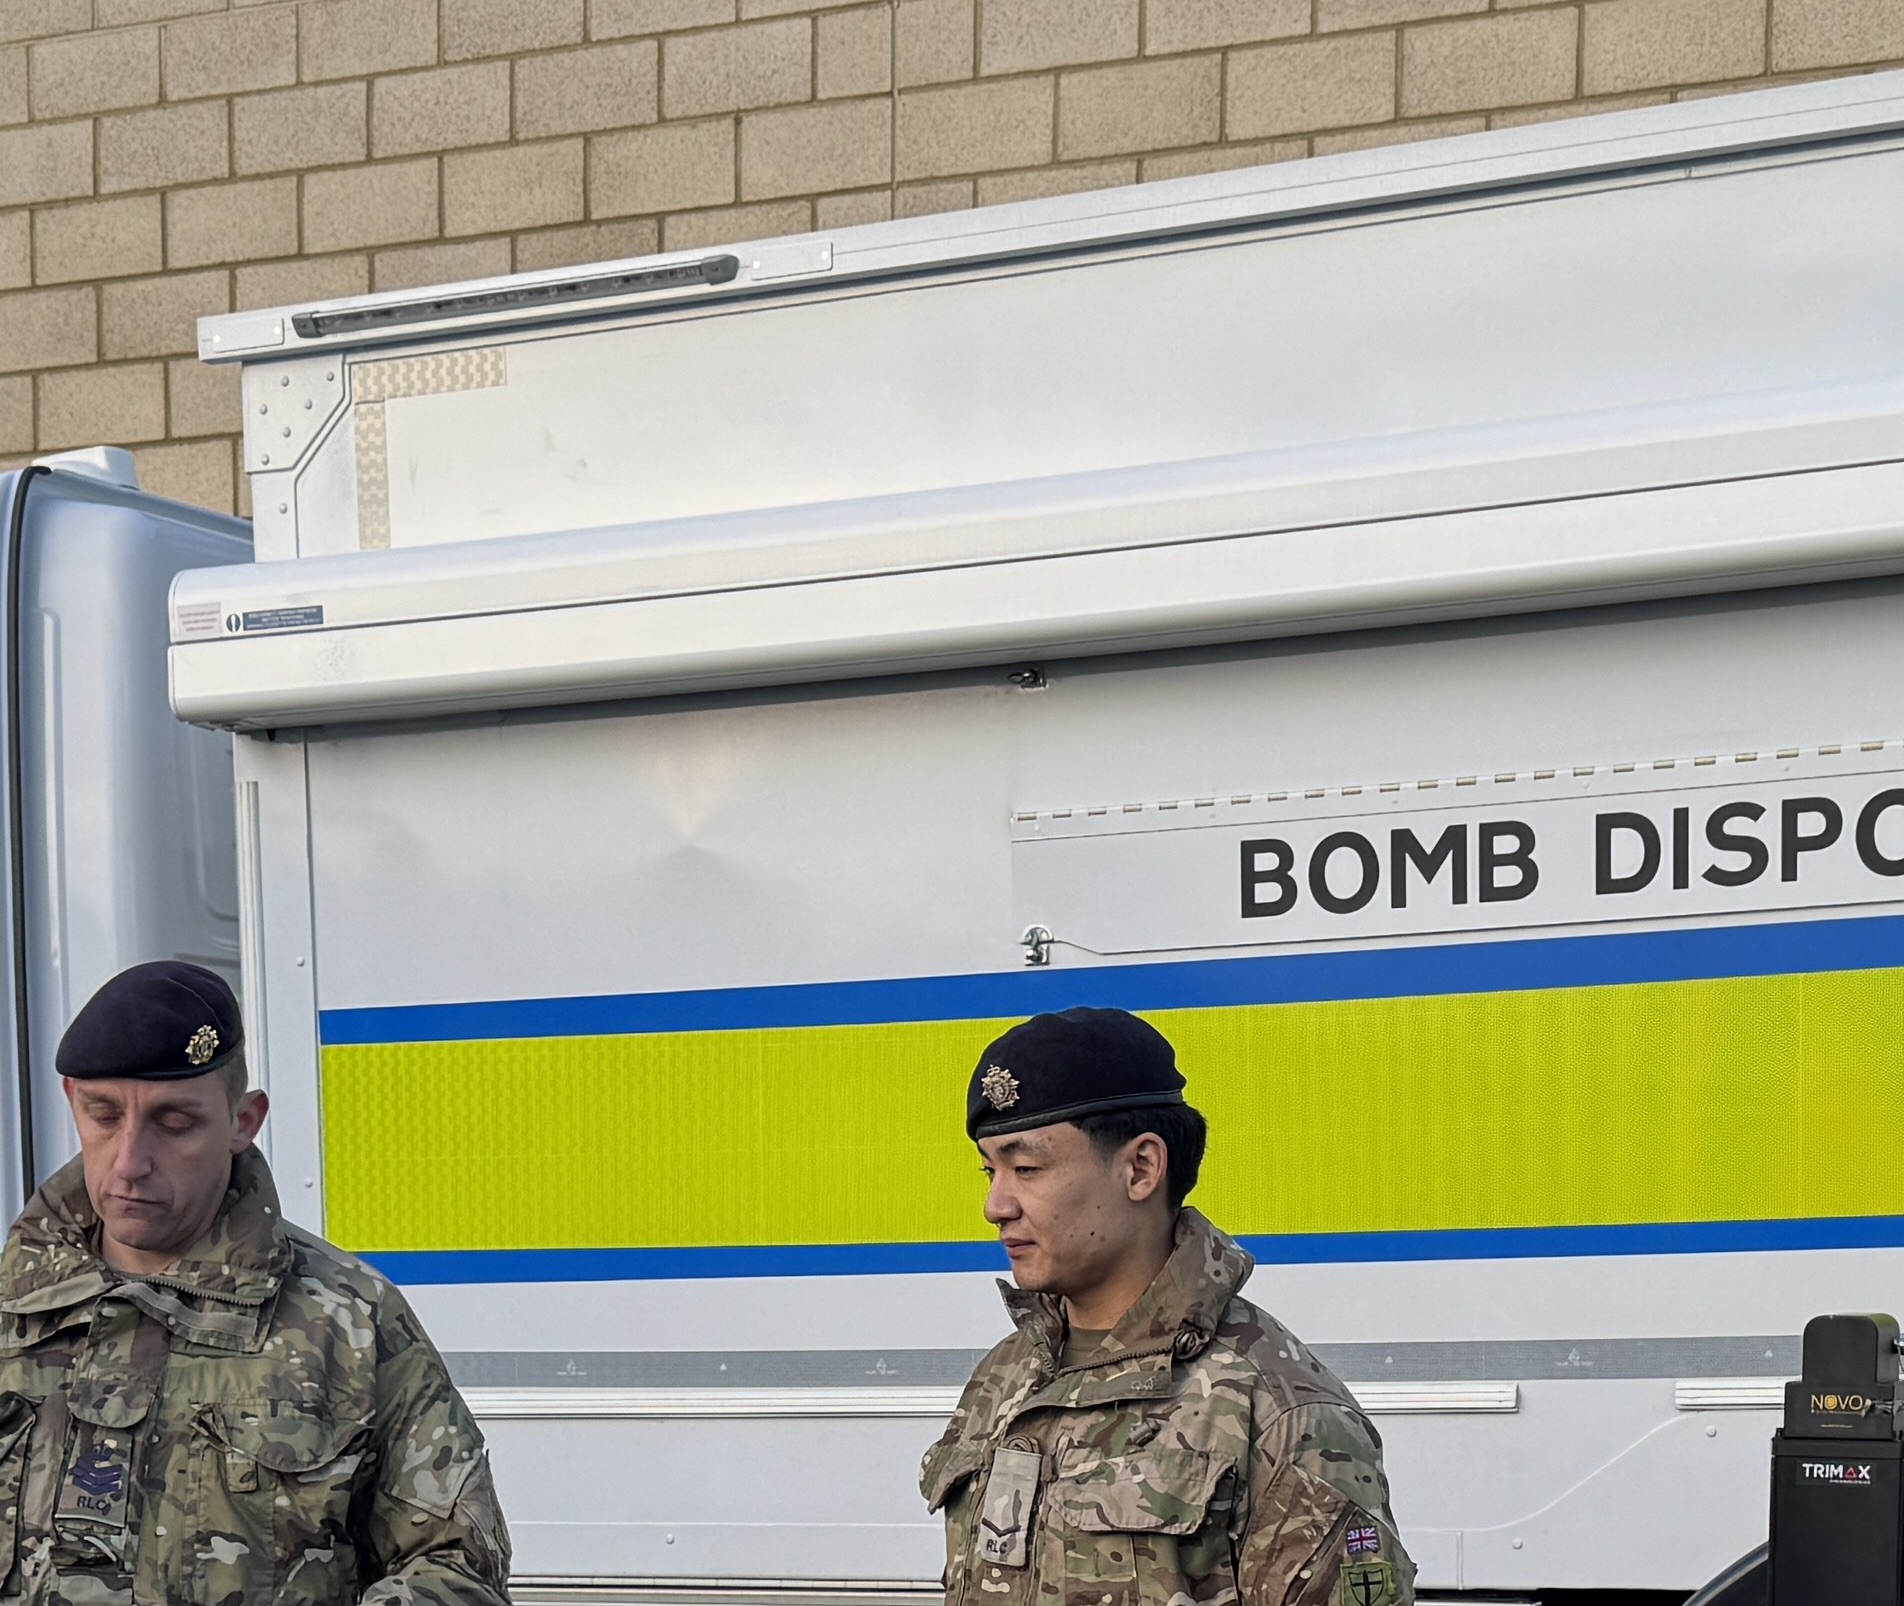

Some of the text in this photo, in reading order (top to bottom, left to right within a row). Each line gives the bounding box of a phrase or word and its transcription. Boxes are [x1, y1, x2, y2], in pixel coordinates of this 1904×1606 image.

[1241, 819, 1540, 918] BOMB
[1811, 1394, 1863, 1411] NOVO
[986, 1538, 1008, 1554] RLC
